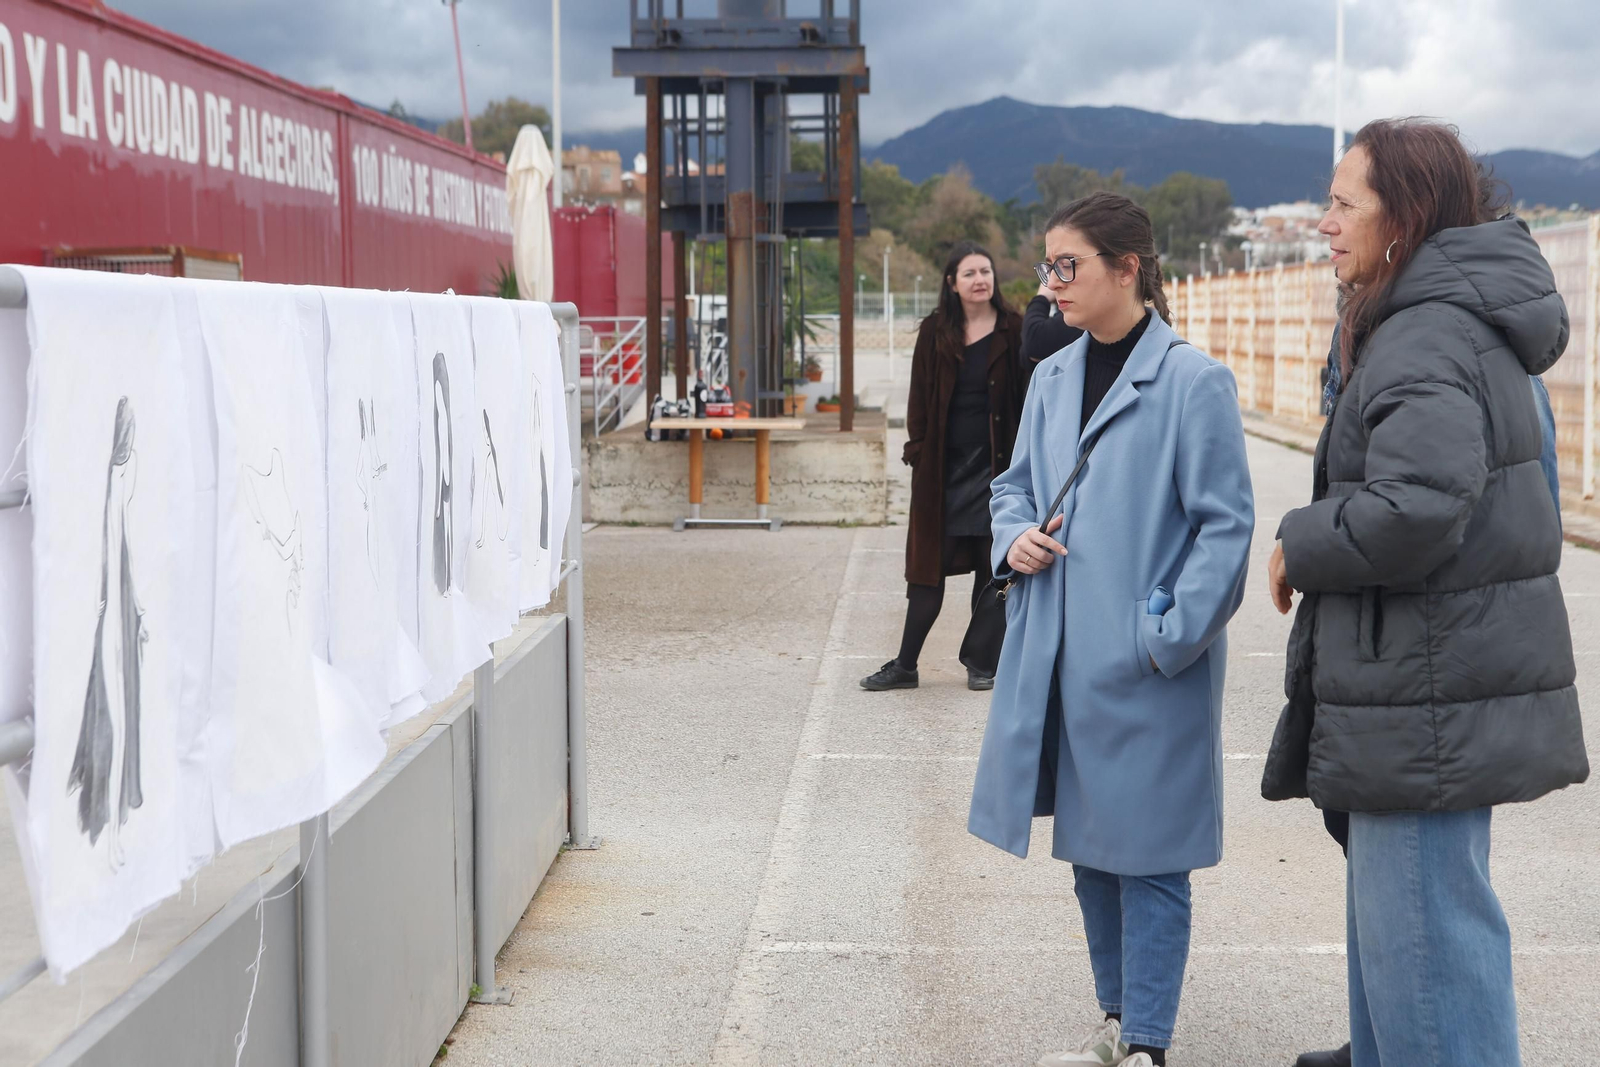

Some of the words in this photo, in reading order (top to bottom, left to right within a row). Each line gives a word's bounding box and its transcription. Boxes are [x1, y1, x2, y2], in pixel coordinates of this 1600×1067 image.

[23, 32, 47, 129] Y
[56, 43, 98, 141] LA
[103, 58, 200, 164] CIUDAD
[204, 91, 234, 171] DE
[239, 104, 339, 207] ALGECIRAS,
[352, 144, 379, 208] 100
[381, 145, 414, 215] AÑOS
[414, 162, 430, 217] DE
[475, 181, 485, 229] Y
